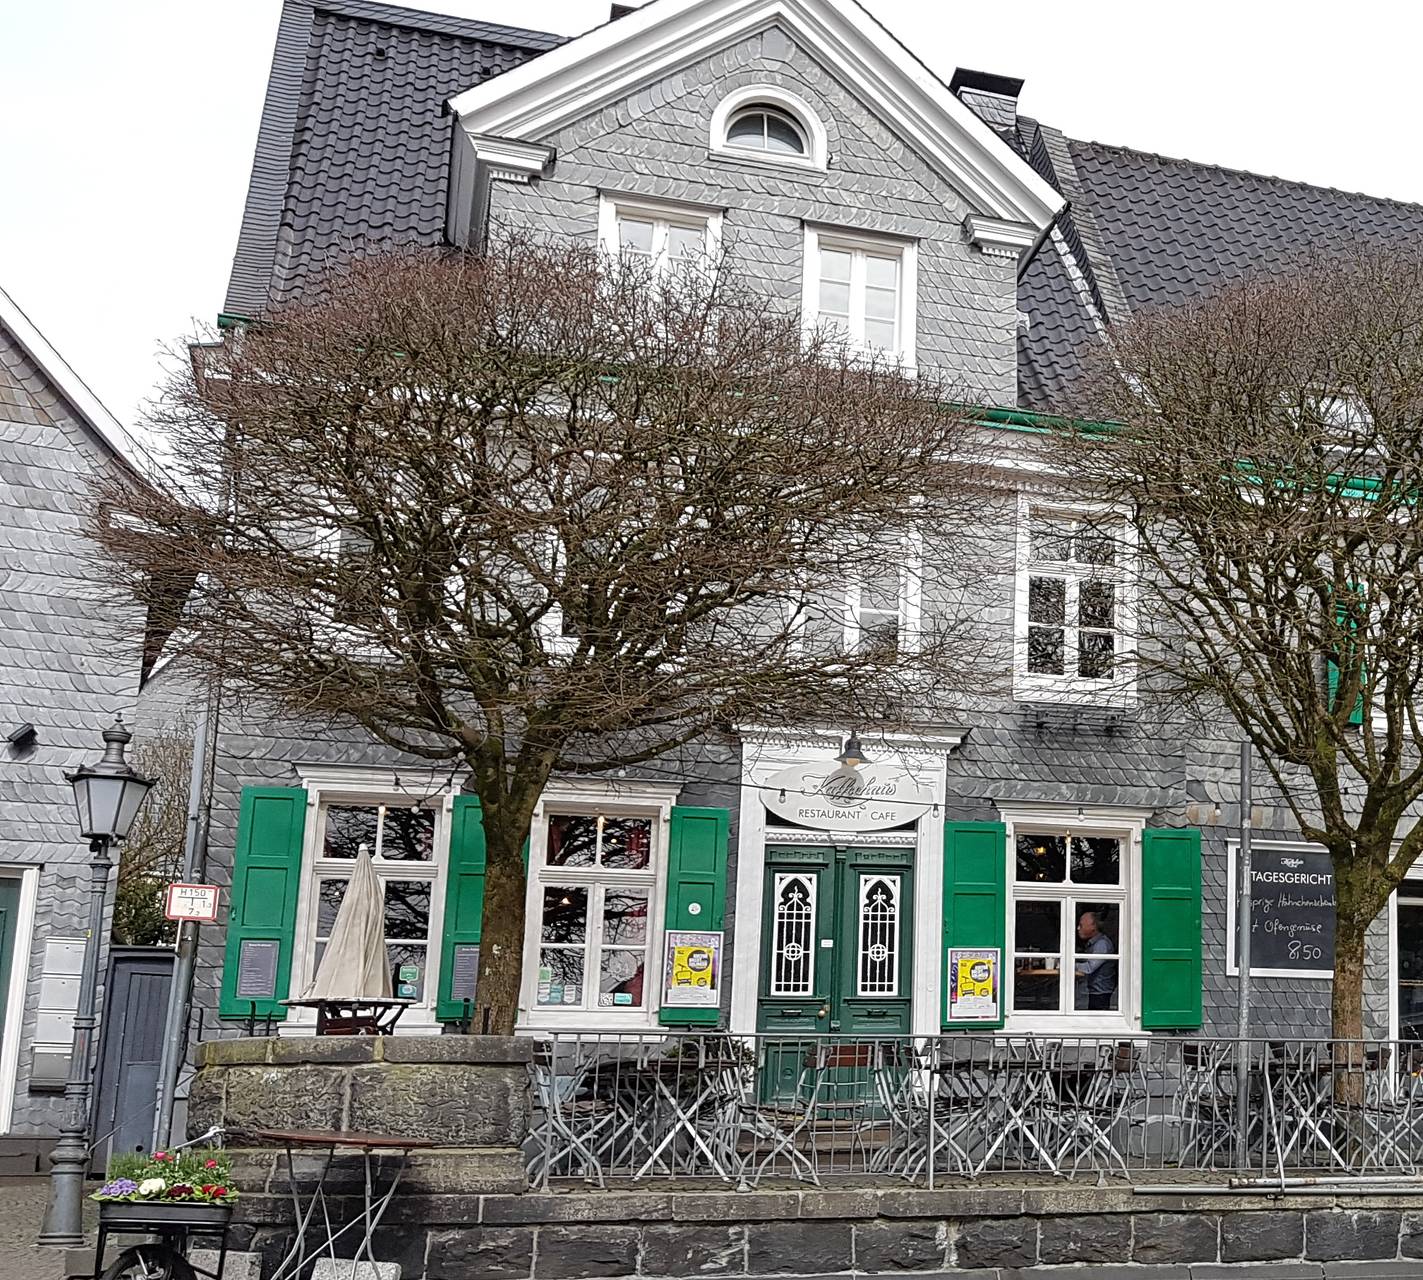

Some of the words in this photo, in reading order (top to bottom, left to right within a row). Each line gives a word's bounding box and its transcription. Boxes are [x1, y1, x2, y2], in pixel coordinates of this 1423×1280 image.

[798, 808, 862, 820] RESTAURANT
[870, 811, 897, 821] CAFE
[1250, 871, 1333, 886] TAGESGERICHT
[1264, 918, 1323, 938] Ofengemüse
